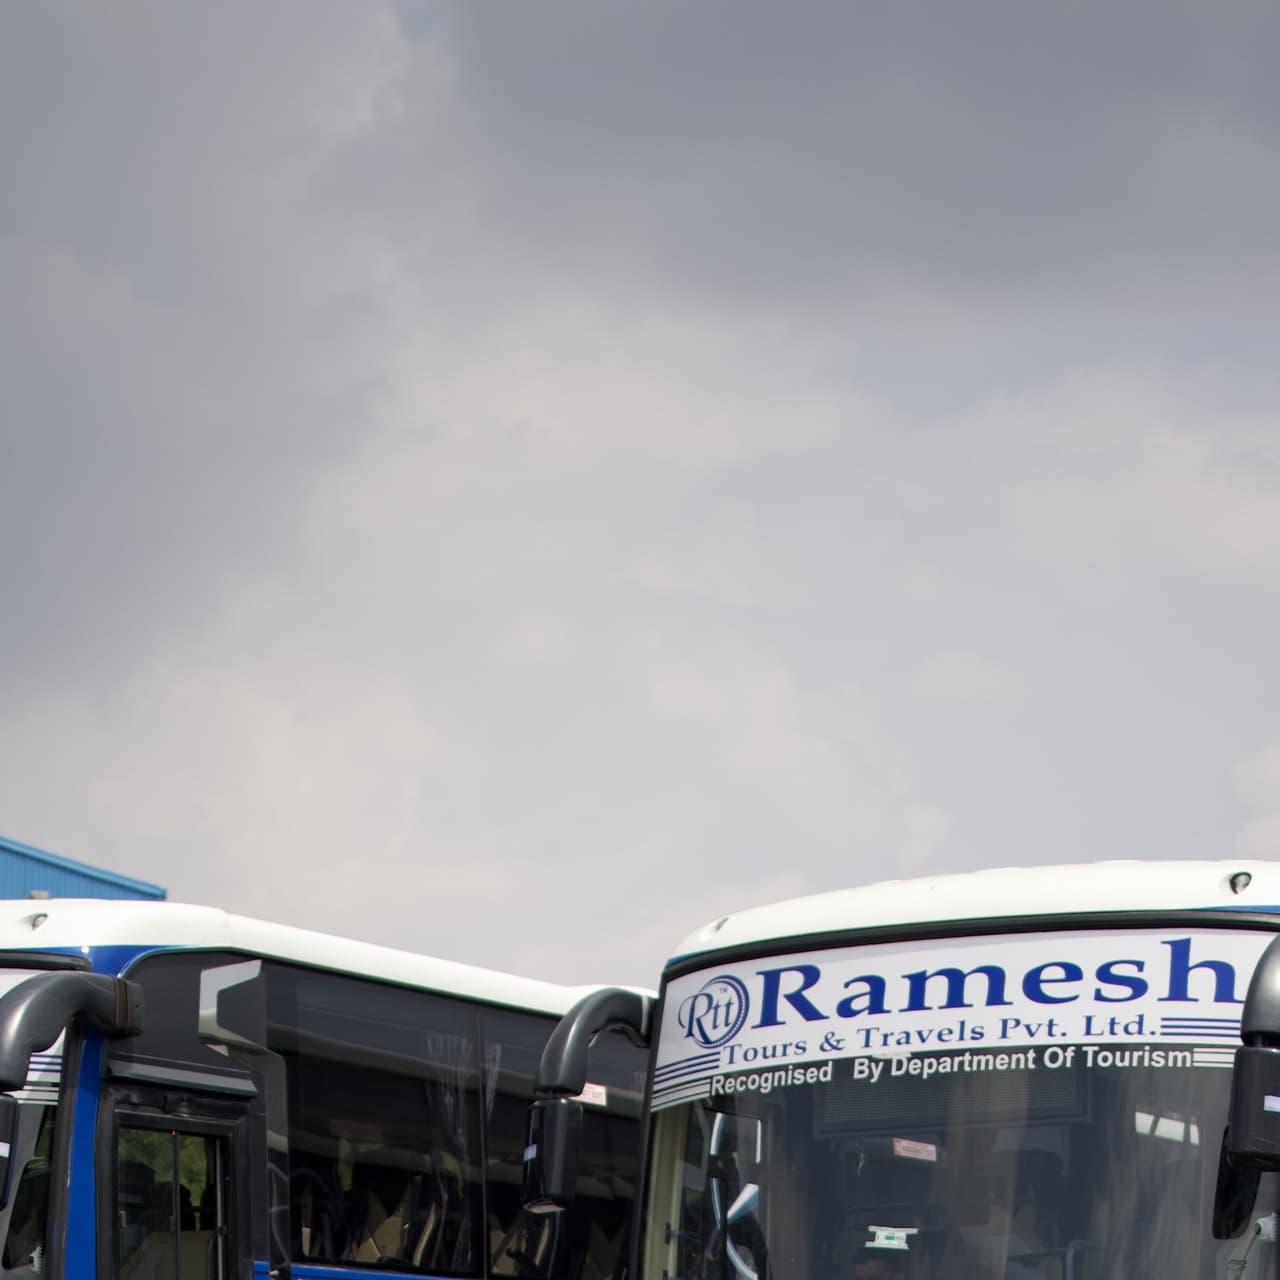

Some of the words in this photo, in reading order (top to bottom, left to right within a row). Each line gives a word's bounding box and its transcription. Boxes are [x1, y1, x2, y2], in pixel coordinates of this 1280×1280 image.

[751, 937, 1246, 1030] Ramesh
[723, 1040, 807, 1065] Tours
[820, 1031, 846, 1052] &
[857, 1020, 985, 1048] Travels
[998, 1017, 1067, 1039] Pvt.
[1083, 1013, 1156, 1036] Ltd.
[711, 1061, 832, 1096] Recognised
[853, 1058, 883, 1083] By
[891, 1048, 1036, 1080] Department
[1043, 1047, 1075, 1068] Of
[1082, 1046, 1192, 1068] Tourism
